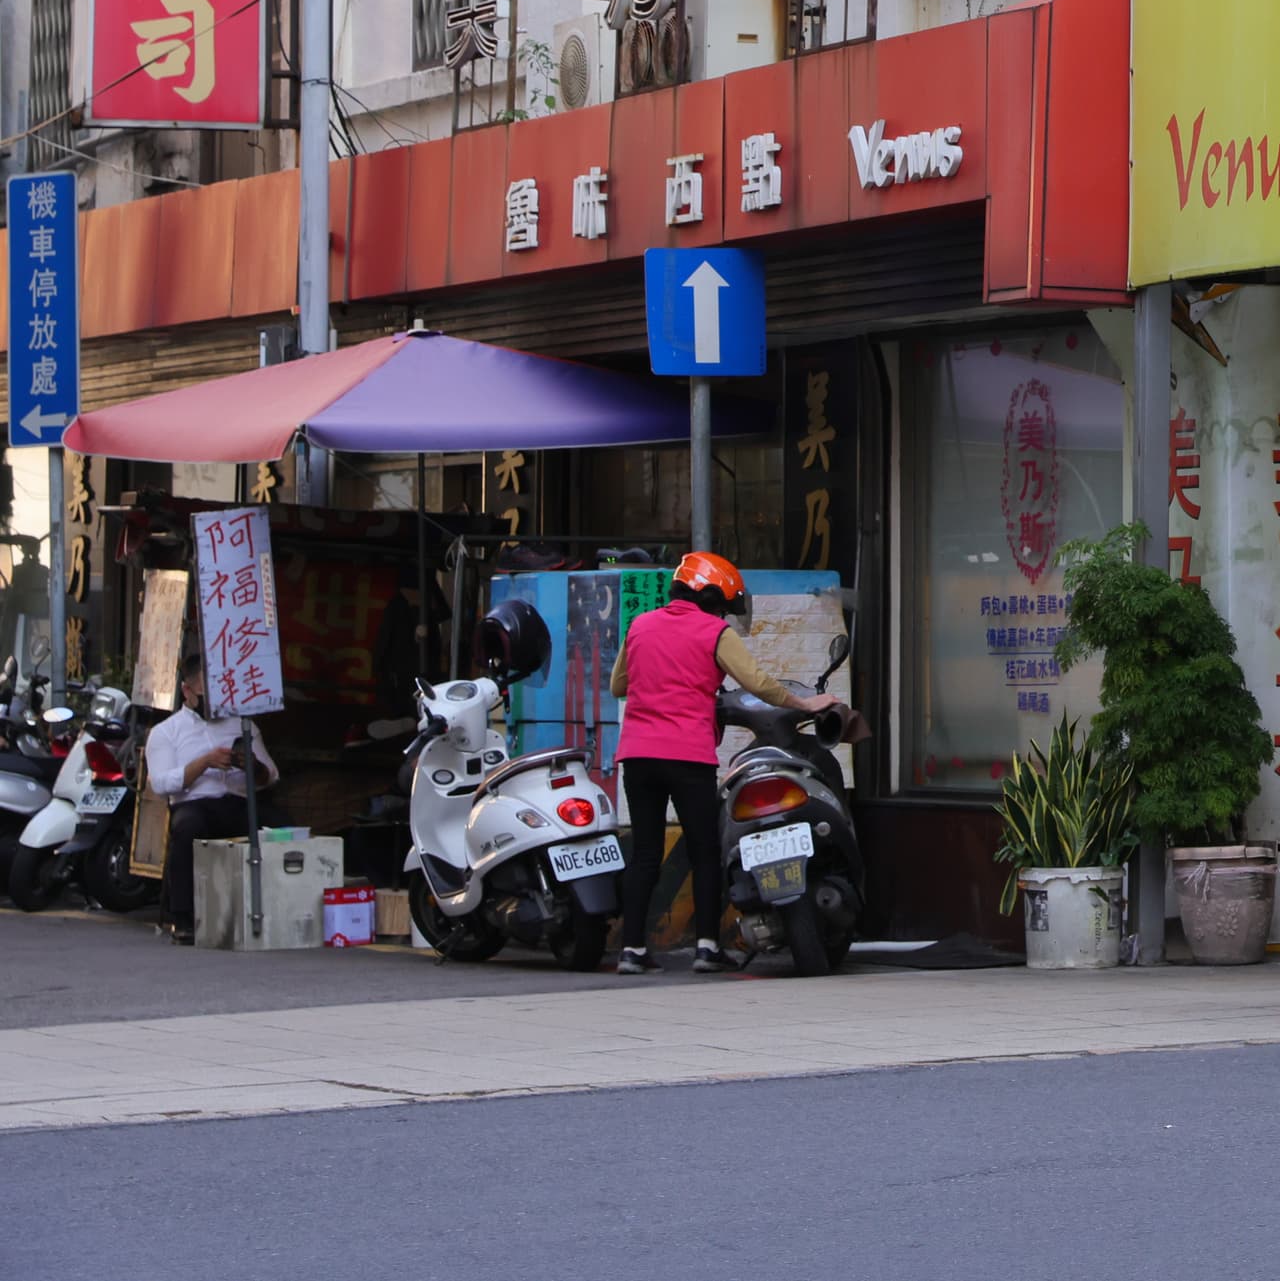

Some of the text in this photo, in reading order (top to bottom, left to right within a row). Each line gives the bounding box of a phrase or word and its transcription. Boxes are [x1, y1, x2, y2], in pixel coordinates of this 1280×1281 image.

[848, 118, 963, 190] Venus
[27, 181, 59, 397] 機車停放處
[1016, 412, 1047, 556] 美乃斯
[204, 511, 271, 706] 阿福修鞋
